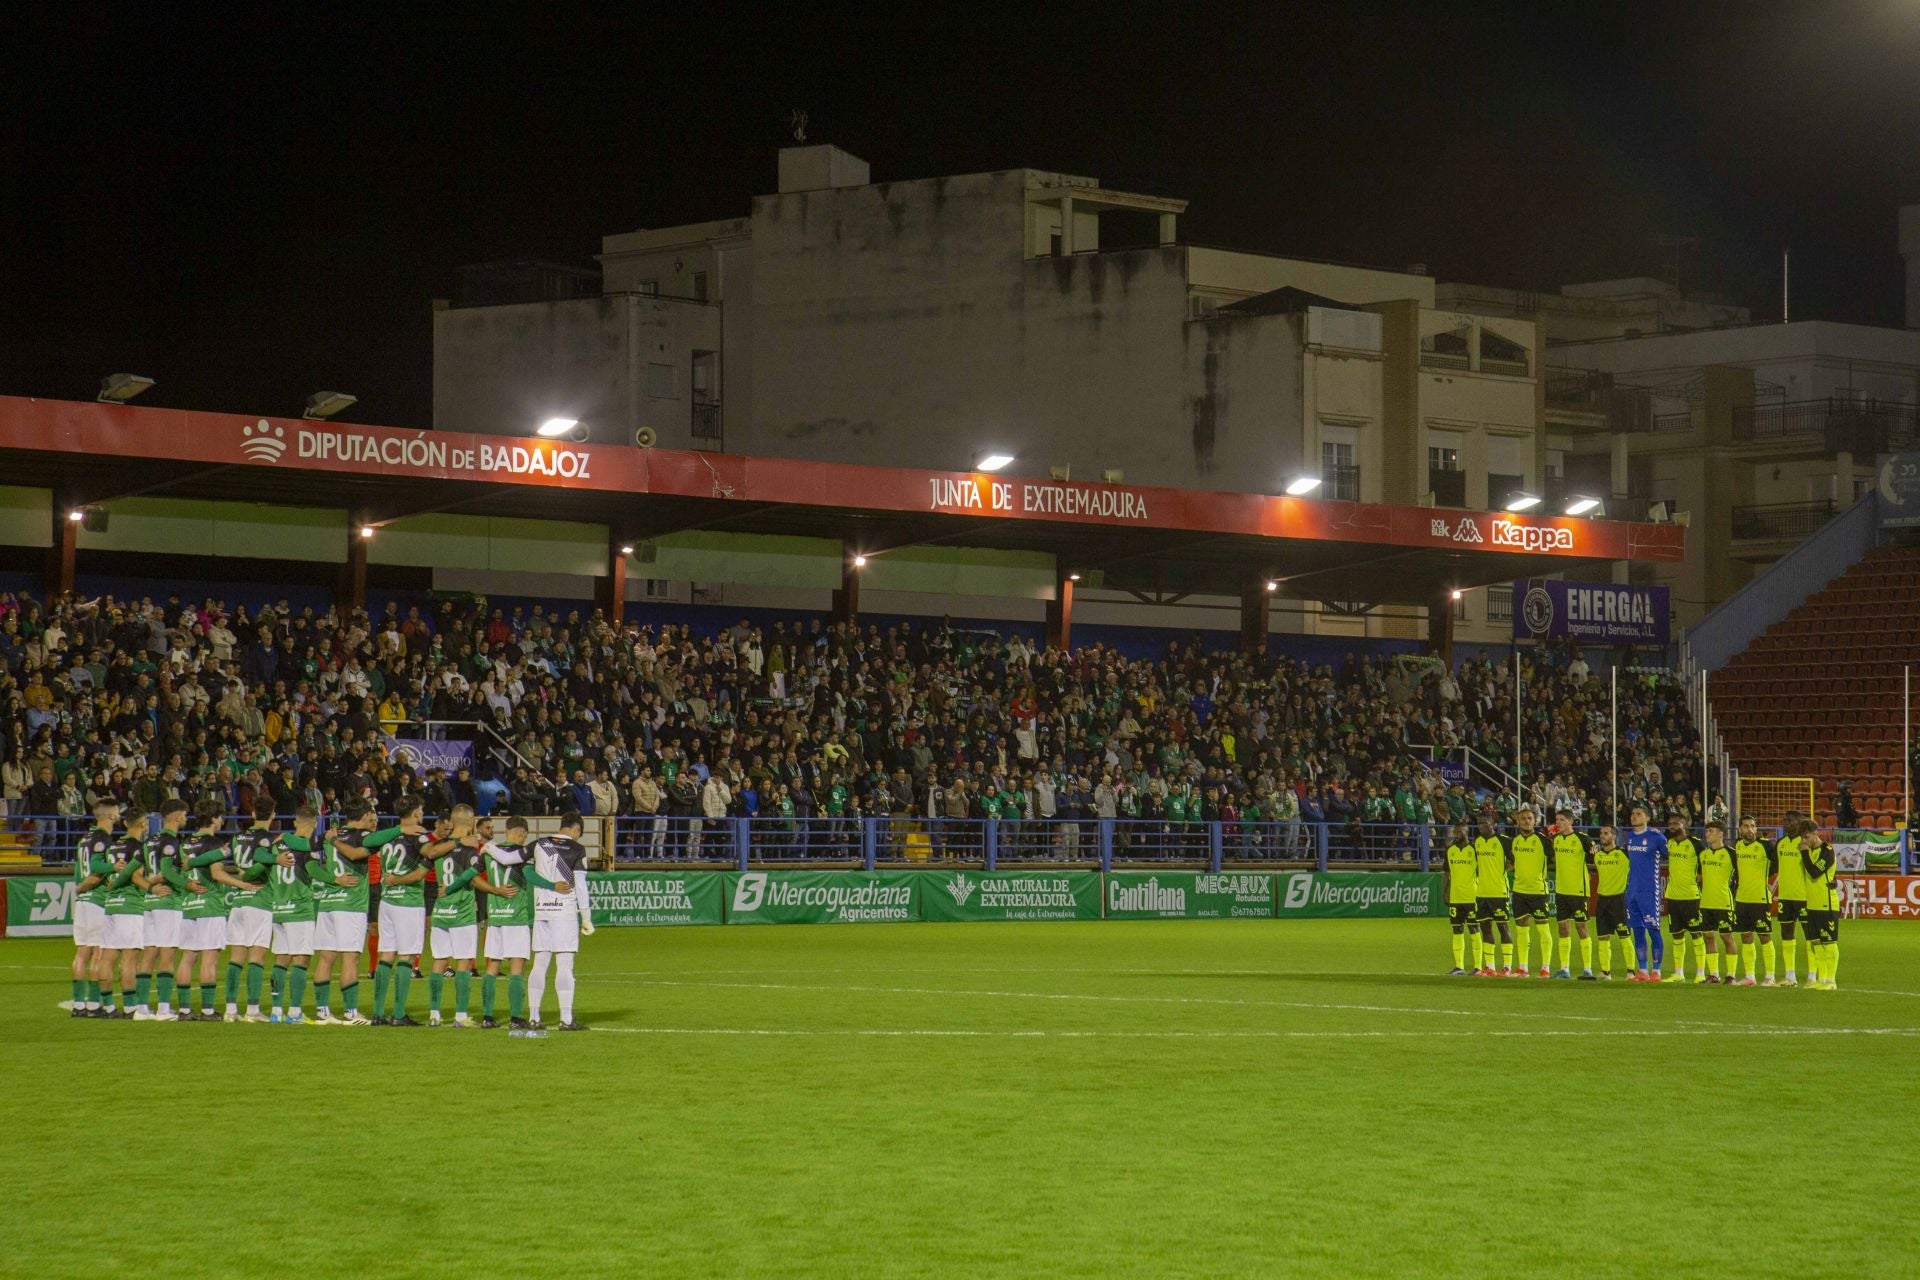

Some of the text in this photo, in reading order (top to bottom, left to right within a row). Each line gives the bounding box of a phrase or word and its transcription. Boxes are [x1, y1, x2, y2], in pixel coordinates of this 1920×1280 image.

[298, 431, 590, 479] DIPUTACIÓN DE BADAJOZ
[930, 478, 1147, 519] JUNTA DE EXTREMADURA
[1492, 520, 1573, 551] Kappa
[1567, 588, 1655, 624] ENERGAL
[382, 843, 408, 875] 22
[442, 857, 454, 886] 8
[587, 880, 684, 895] AJA RURAL DE
[767, 880, 911, 912] Mercoguadiana
[980, 879, 1069, 893] CAJA RURAL DE
[1109, 876, 1186, 911] Cantillana
[1195, 875, 1270, 894] MECARUX
[1312, 880, 1430, 909] Mercoguadiana
[590, 895, 692, 910] XTREMADURA
[839, 906, 908, 922] Agricentros
[980, 893, 1077, 907] EXTREMADURA
[1403, 903, 1428, 915] Grupo
[1881, 905, 1893, 915] &
